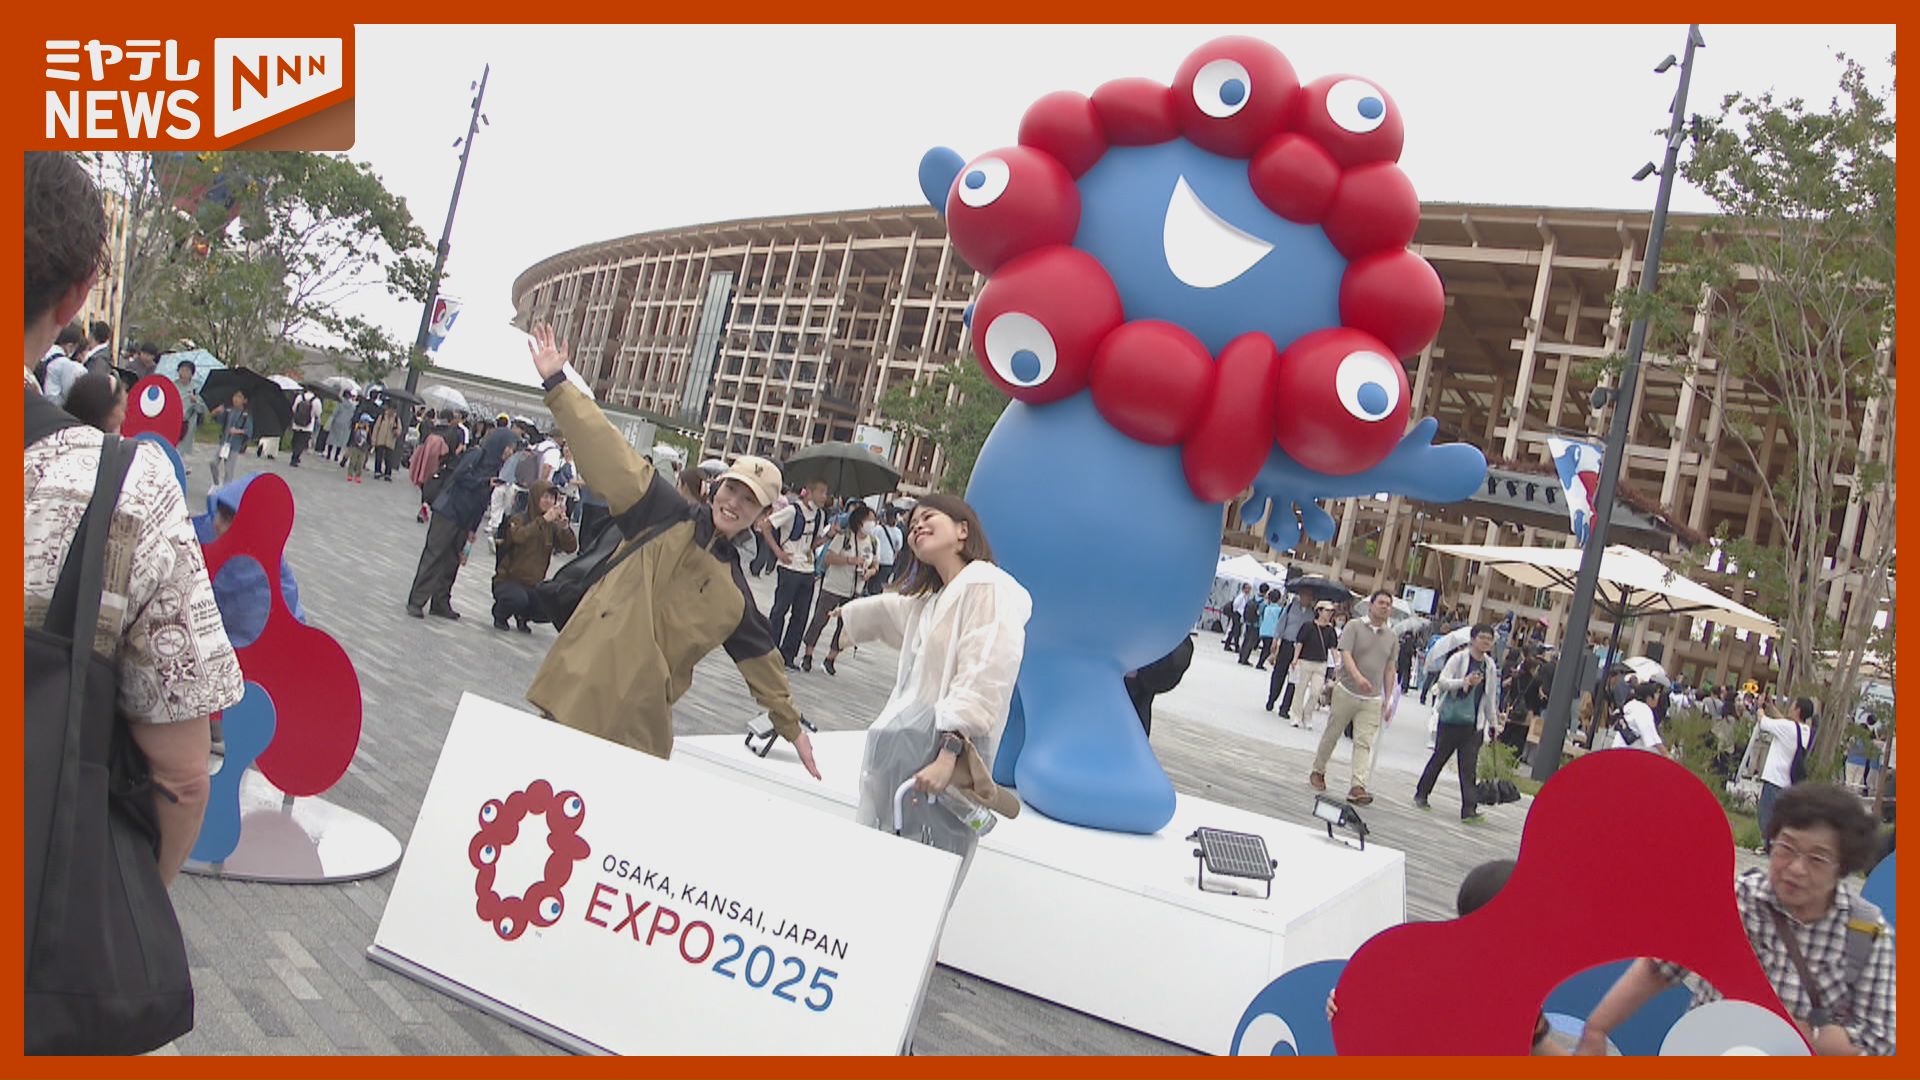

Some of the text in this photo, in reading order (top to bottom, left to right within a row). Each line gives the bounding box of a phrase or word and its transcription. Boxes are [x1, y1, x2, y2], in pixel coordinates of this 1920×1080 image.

[584, 882, 839, 1012] EXPO2025
[602, 854, 849, 960] OSAKA, KANSAI, JAPAN
